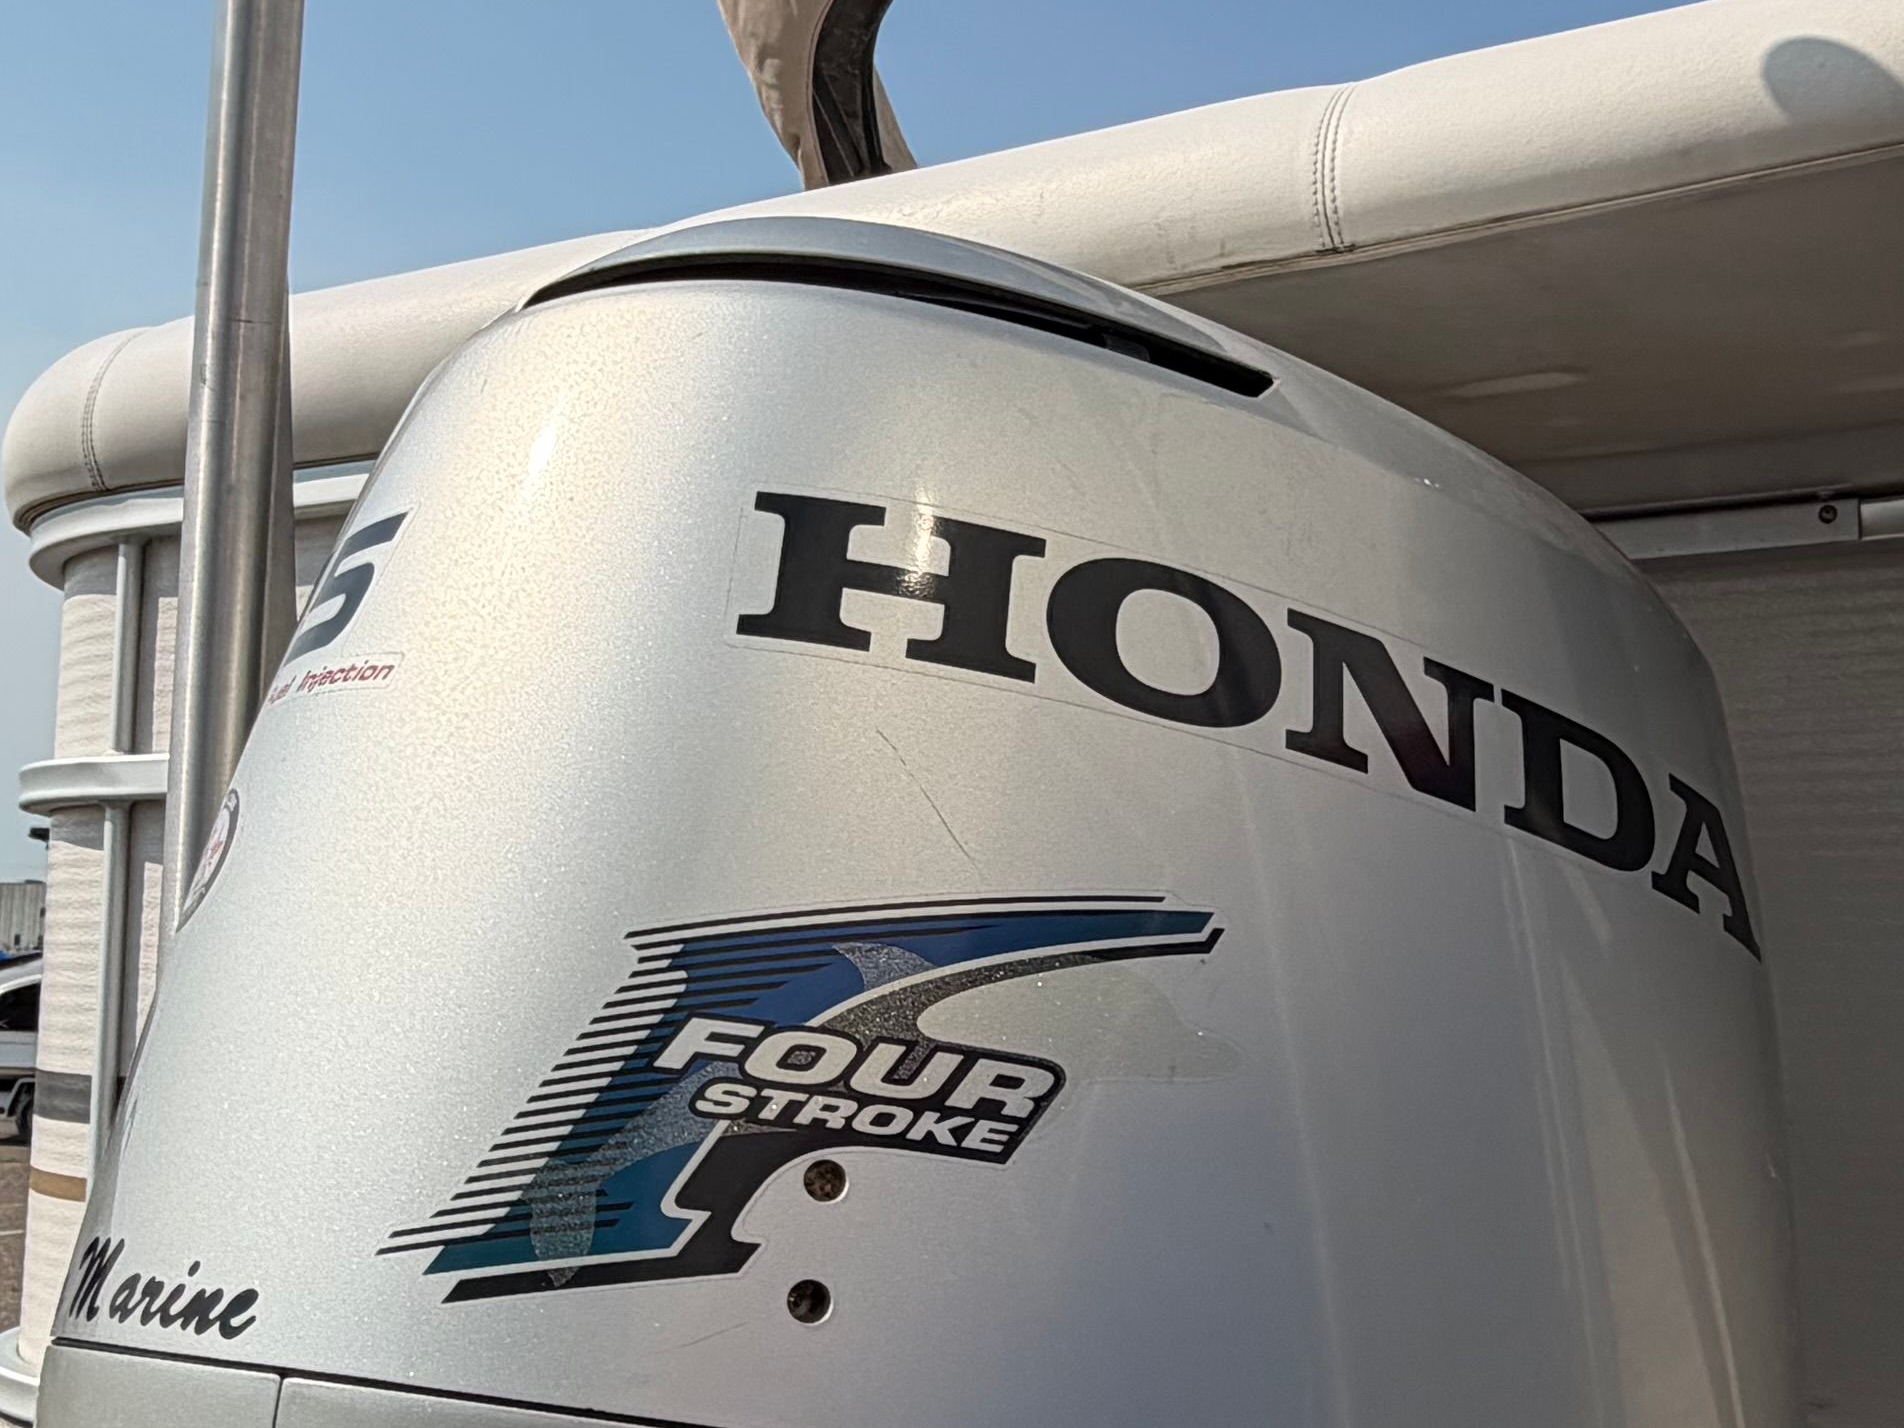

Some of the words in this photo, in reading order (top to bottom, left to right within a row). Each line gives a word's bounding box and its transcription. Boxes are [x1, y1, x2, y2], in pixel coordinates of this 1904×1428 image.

[296, 660, 395, 693] Injection
[736, 490, 1761, 963] HONDA
[653, 1017, 1056, 1119] FOUR
[695, 1082, 1020, 1154] STROKE
[69, 1236, 259, 1340] Marine
